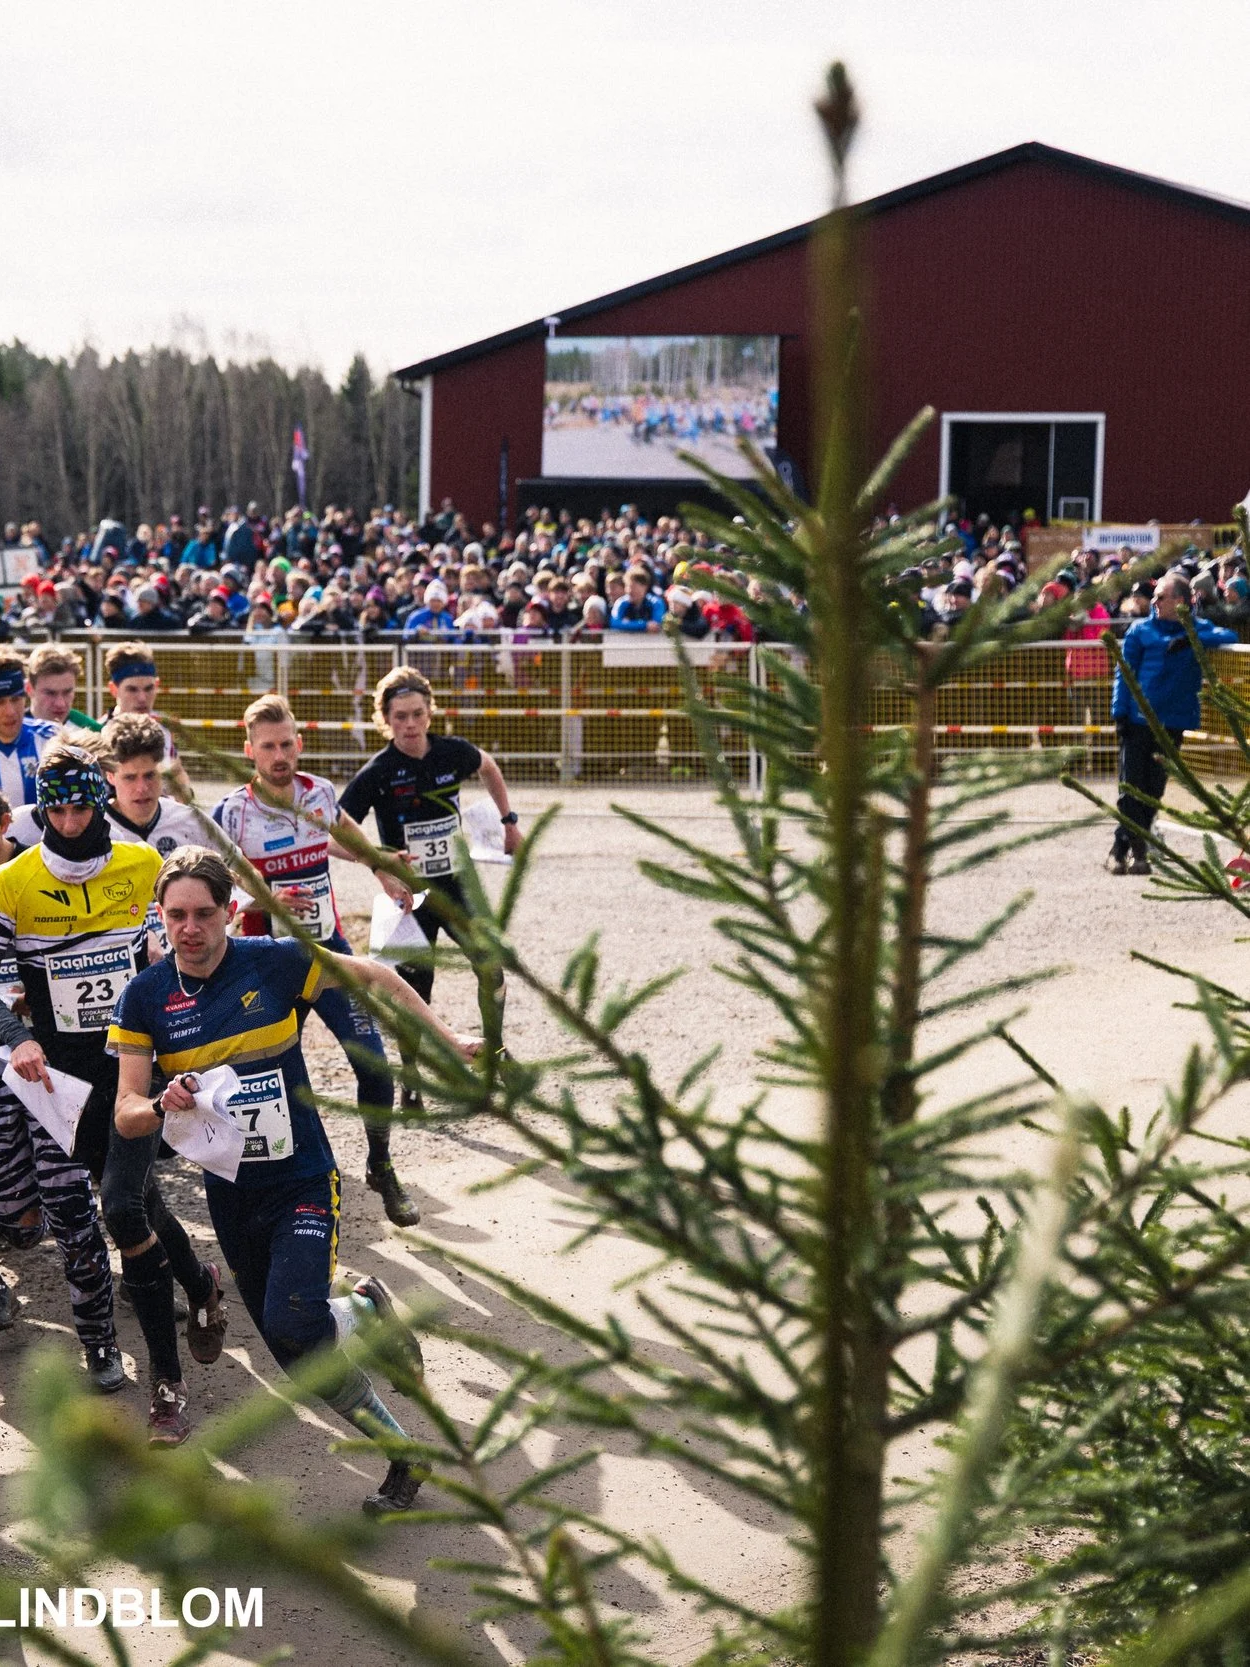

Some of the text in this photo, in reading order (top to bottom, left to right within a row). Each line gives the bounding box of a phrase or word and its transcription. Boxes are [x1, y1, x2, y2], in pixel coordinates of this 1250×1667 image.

[1099, 533, 1153, 544] INFORMATION
[424, 840, 448, 858] 33
[264, 859, 288, 873] OK
[34, 915, 78, 923] noname
[49, 948, 129, 971] bagheera
[75, 978, 114, 1004] 23
[165, 1000, 196, 1012] KVANTUM
[169, 1025, 202, 1040] TRIMTEX
[274, 1102, 281, 1113] 1
[293, 1228, 326, 1239] TRIMTEX
